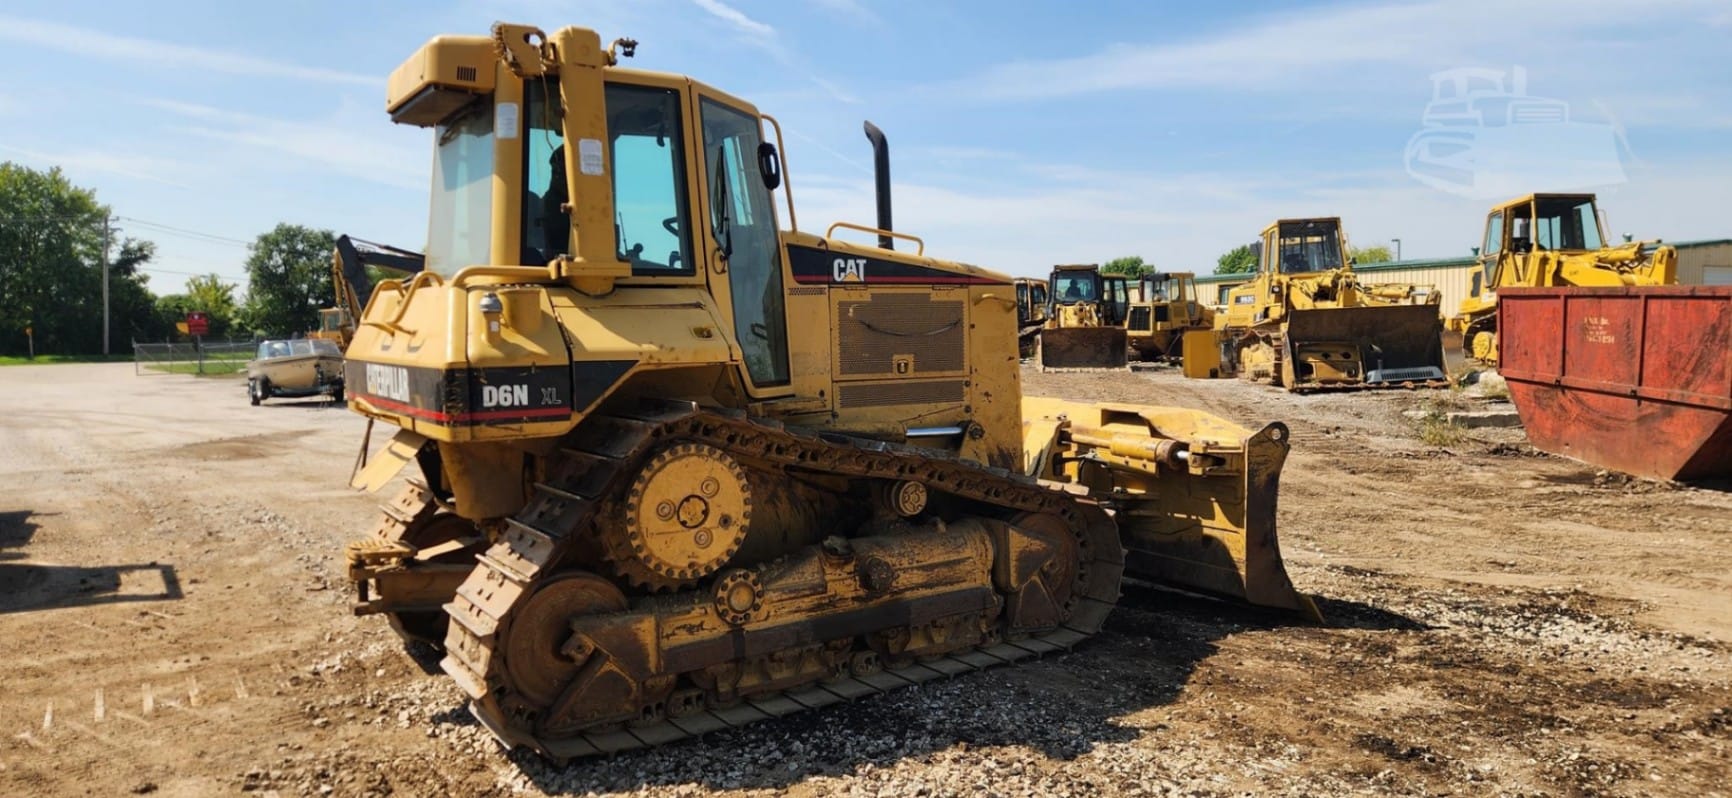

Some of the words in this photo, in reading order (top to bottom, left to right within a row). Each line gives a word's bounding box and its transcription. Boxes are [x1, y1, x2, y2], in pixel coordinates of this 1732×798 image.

[833, 258, 867, 281] CAT
[482, 384, 529, 407] D6N
[541, 387, 562, 405] XL
